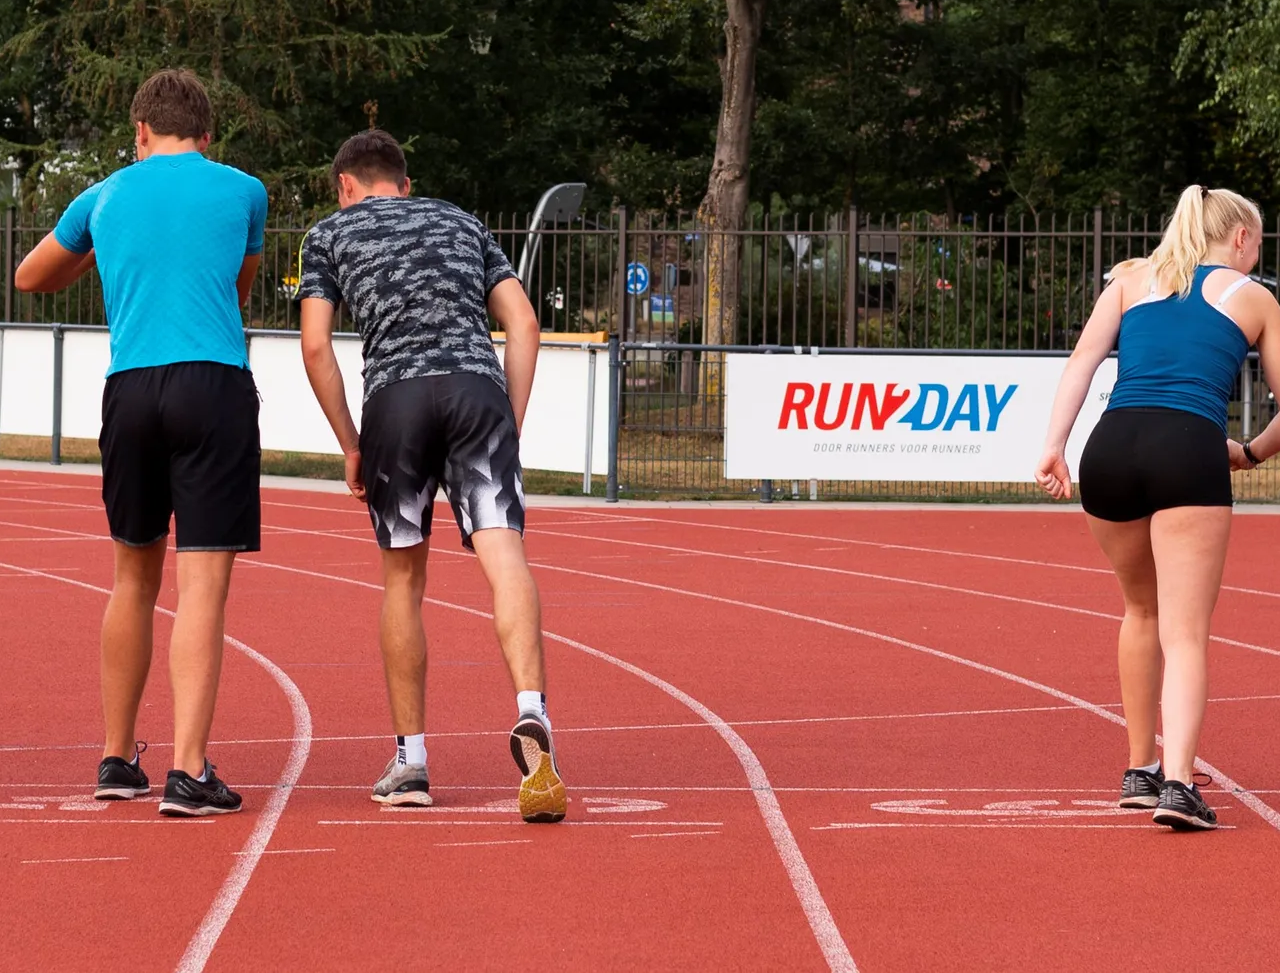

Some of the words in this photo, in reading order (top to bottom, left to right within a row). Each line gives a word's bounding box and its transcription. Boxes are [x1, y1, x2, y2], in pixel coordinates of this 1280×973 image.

[777, 381, 1019, 432] RUN2DAY
[813, 443, 842, 453] DOOR
[846, 443, 896, 453] RUNNERS
[900, 444, 928, 454] VOOR
[931, 444, 982, 454] RUNNERS
[397, 747, 407, 766] NIKE
